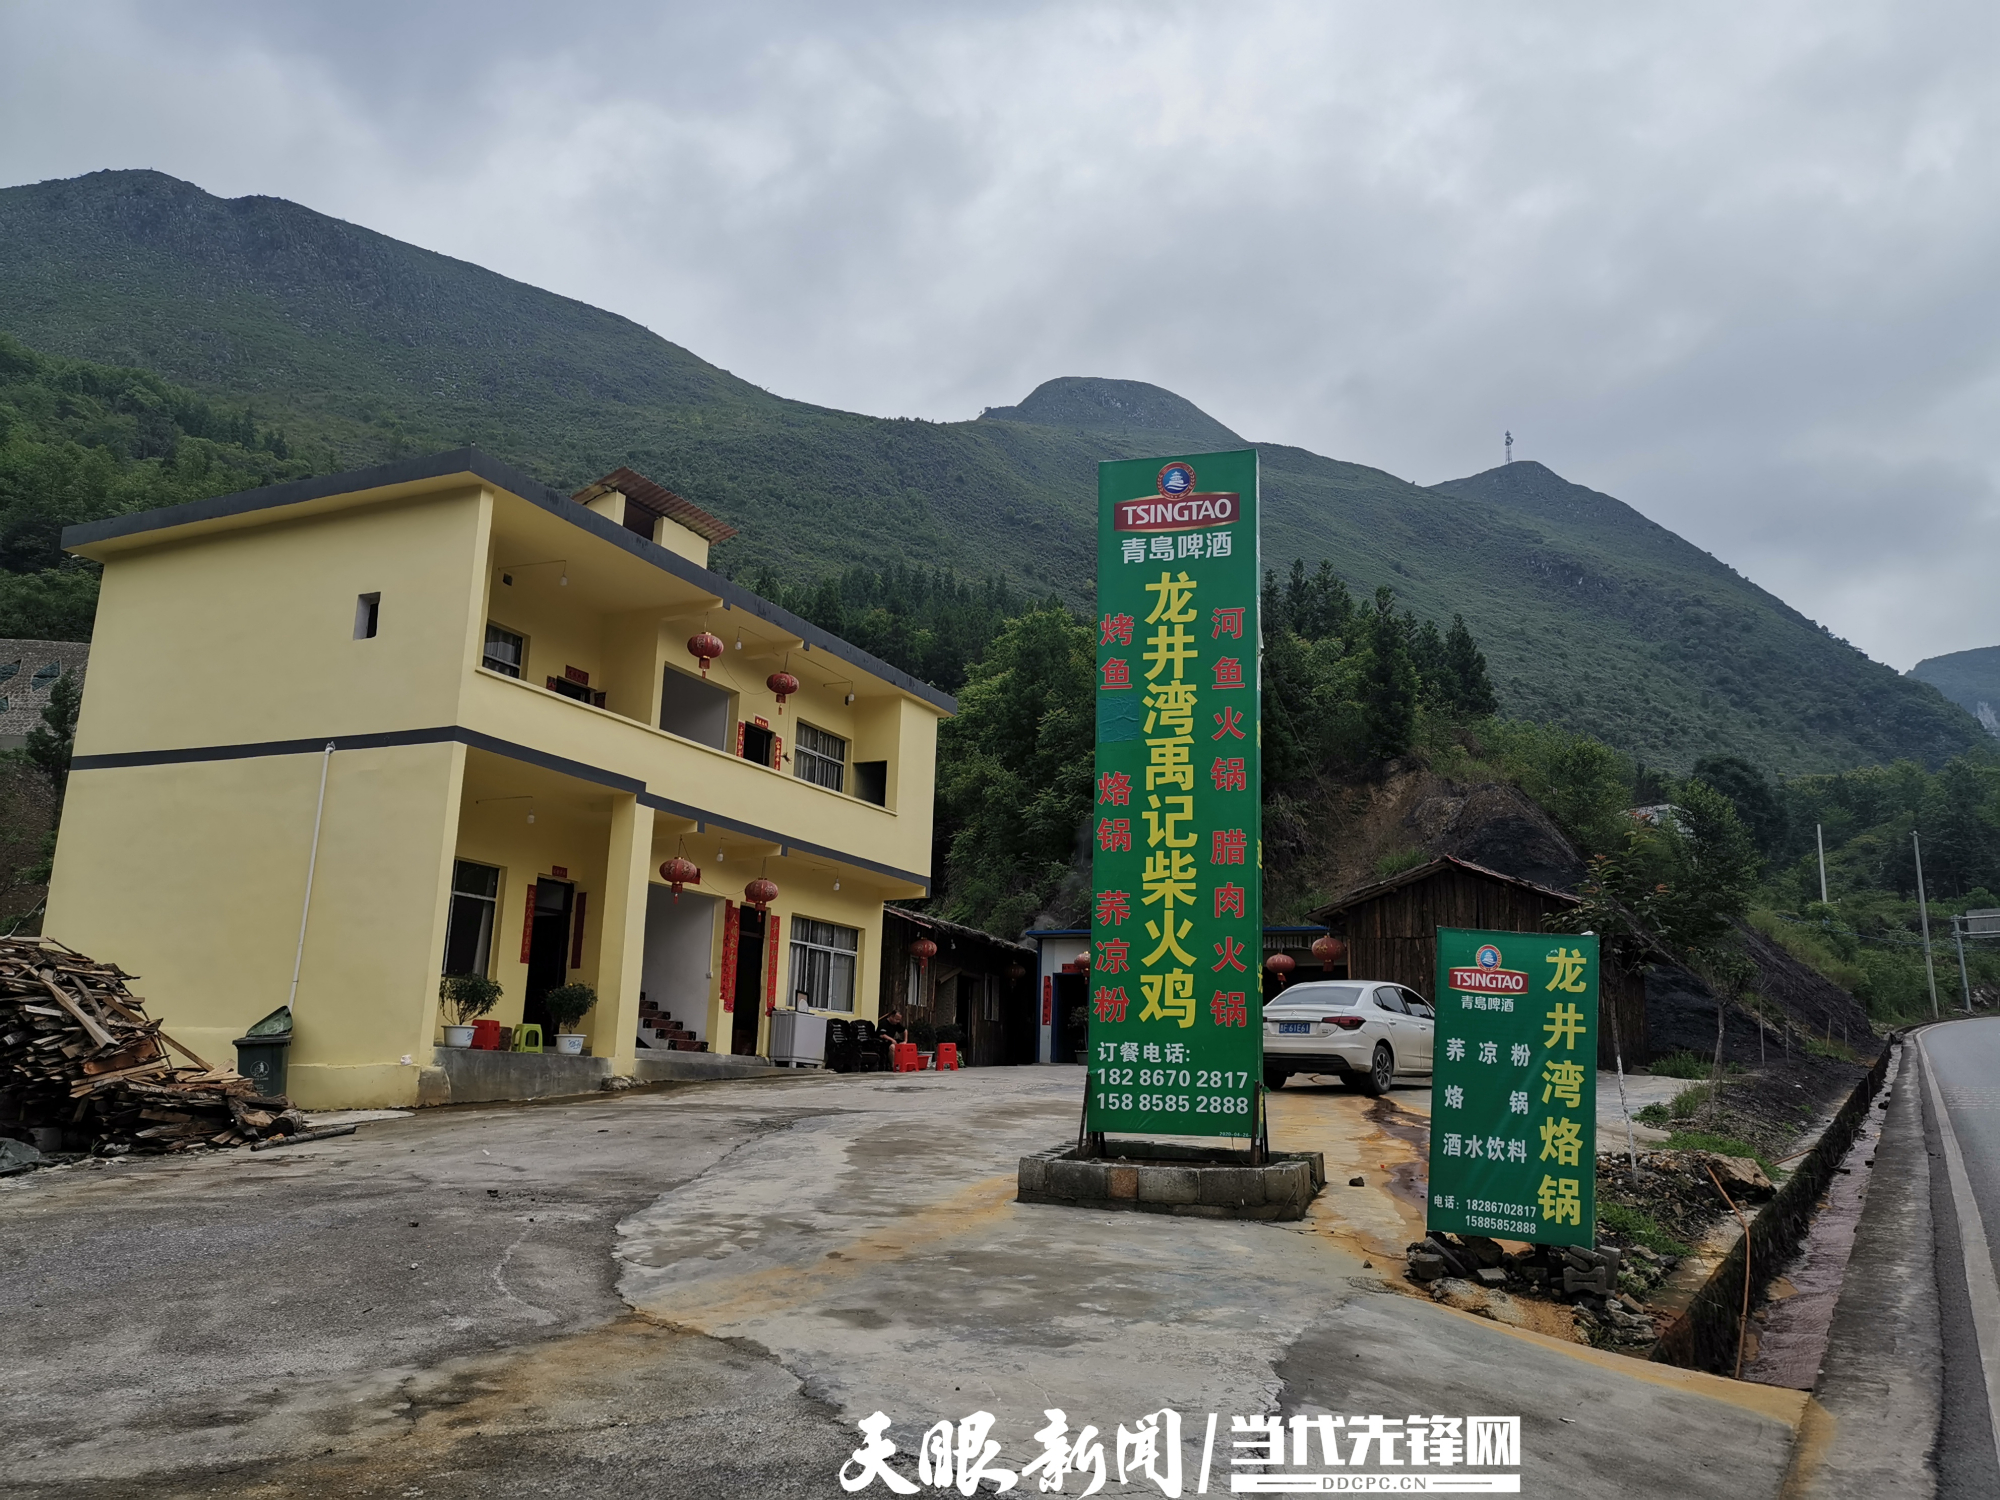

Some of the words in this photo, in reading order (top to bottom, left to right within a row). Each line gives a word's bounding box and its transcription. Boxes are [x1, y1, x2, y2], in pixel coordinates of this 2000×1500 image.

[1121, 498, 1232, 525] TSINGTAO
[1099, 613, 1134, 690] 烤鱼
[1211, 607, 1246, 792] 河鱼火锅
[1096, 771, 1133, 852] 烙锅
[1138, 571, 1198, 1028] 龙井湾禹记柴火鸡
[1210, 829, 1247, 1028] 腊肉火锅
[1093, 890, 1131, 1023] 荞凉粉
[1453, 971, 1524, 990] TSINGTAO
[1097, 1042, 1190, 1064] 订餐电话：
[1097, 1068, 1134, 1085] 182
[1139, 1069, 1191, 1087] 8670
[1196, 1071, 1248, 1089] 2817
[1537, 947, 1587, 1226] 龙井湾烙锅
[1096, 1093, 1133, 1110] 158
[1138, 1094, 1190, 1112] 8585
[1195, 1096, 1249, 1114] 2888
[1442, 1132, 1527, 1164] 酒水饮料
[1465, 1215, 1536, 1234] 15885852888
[1466, 1199, 1536, 1218] 18286702817
